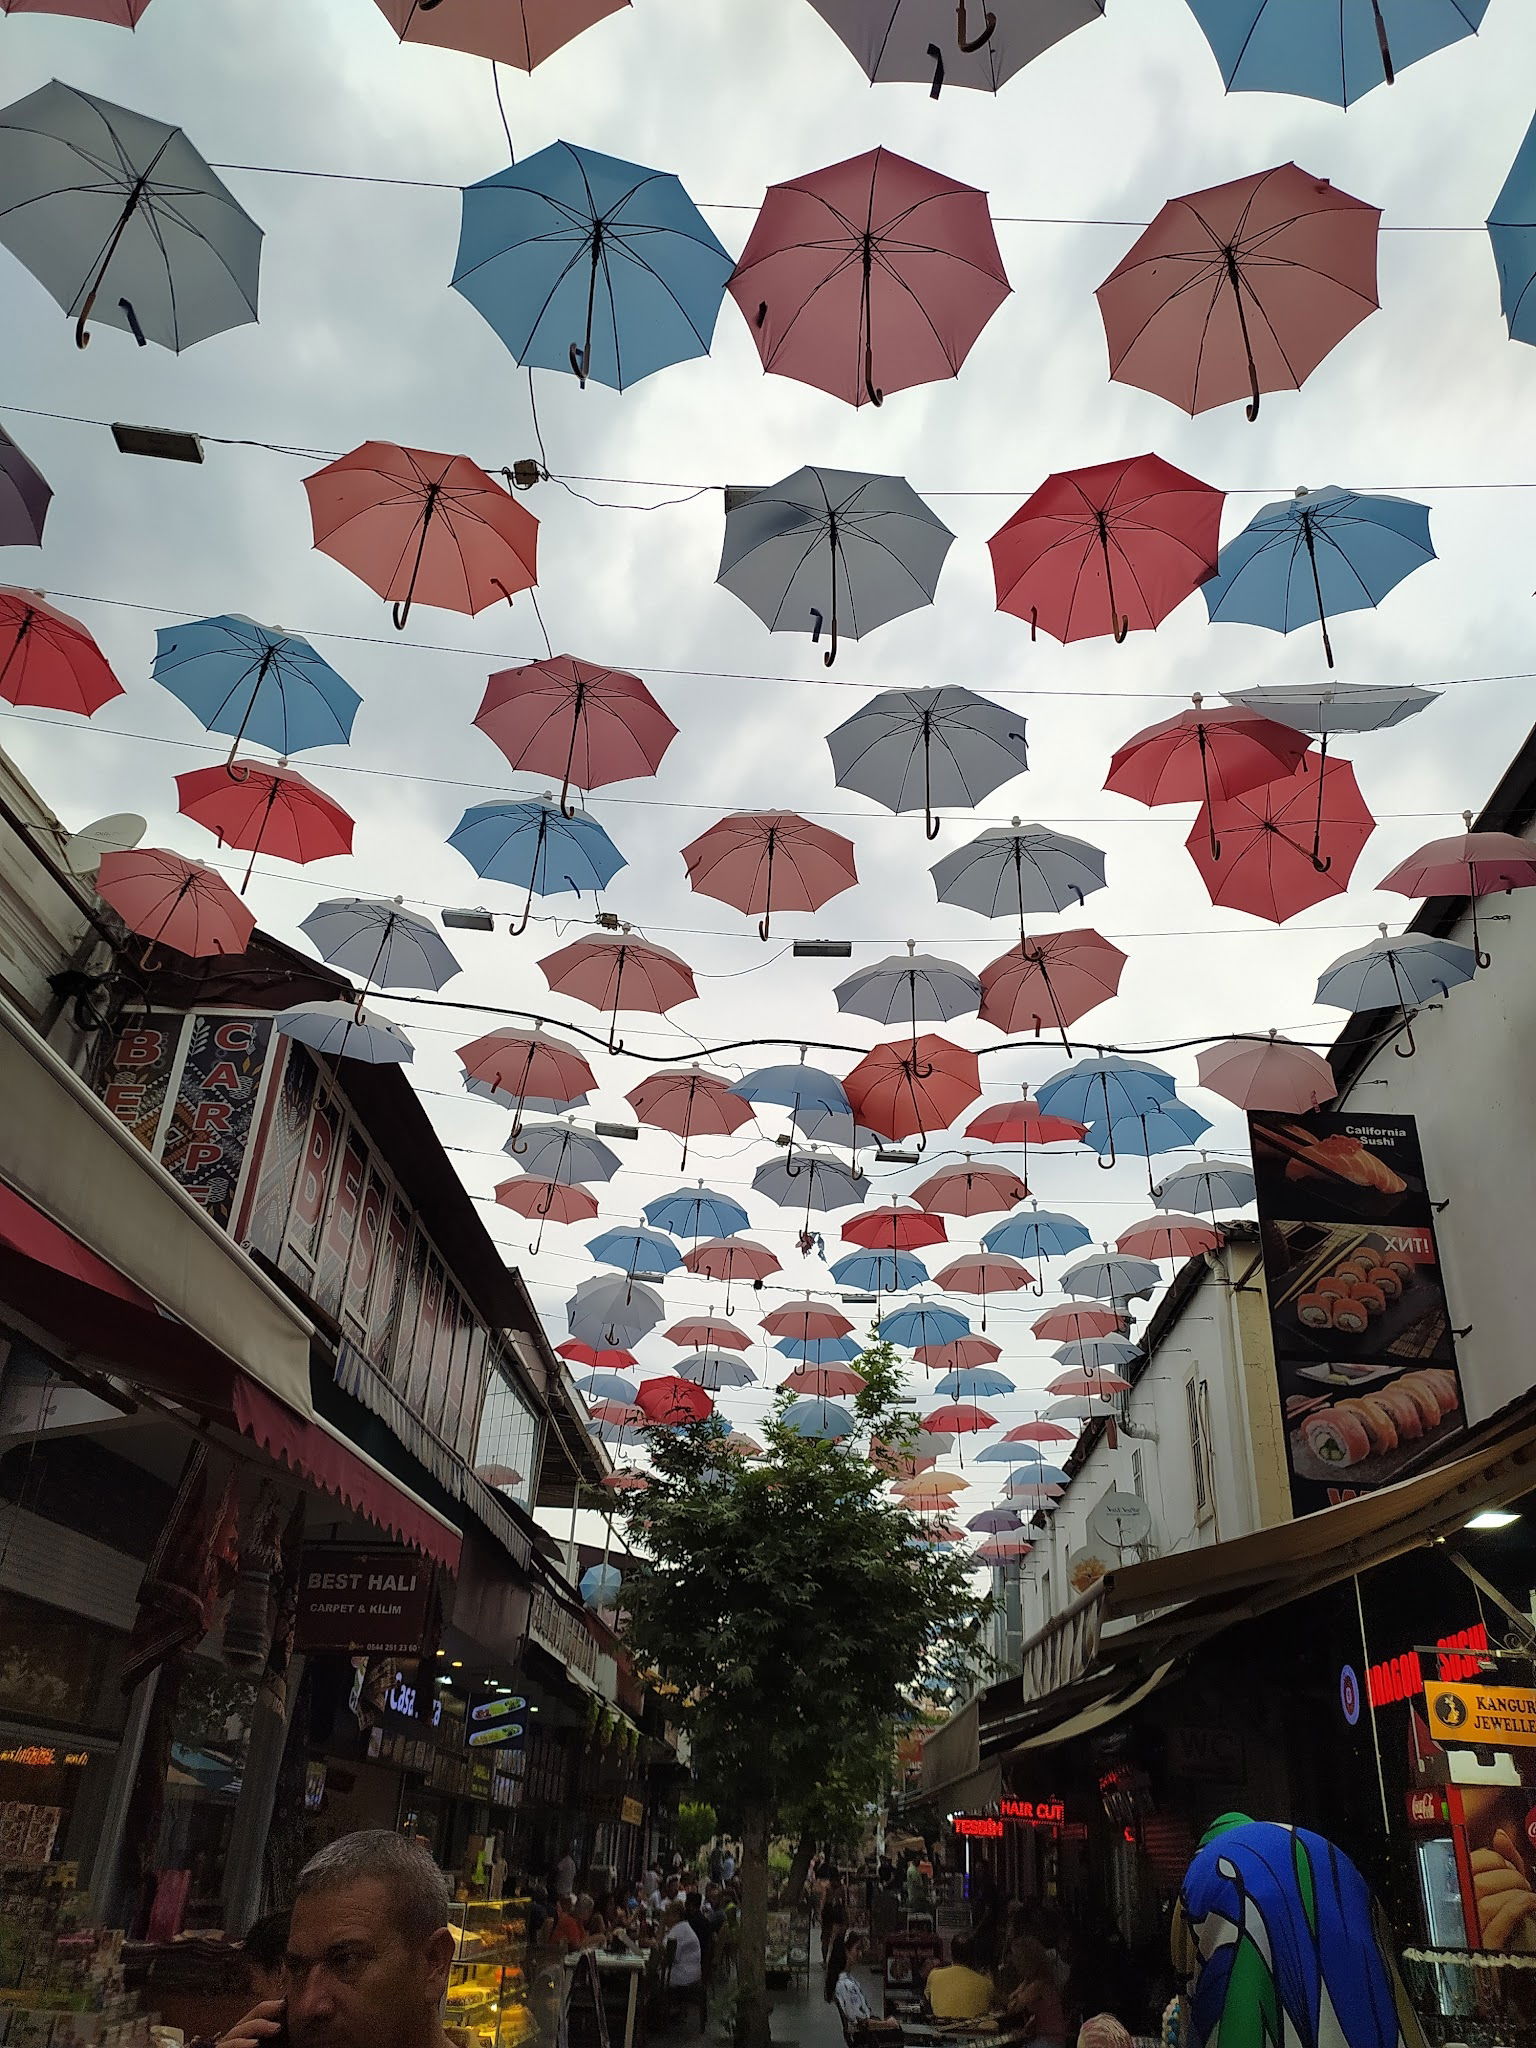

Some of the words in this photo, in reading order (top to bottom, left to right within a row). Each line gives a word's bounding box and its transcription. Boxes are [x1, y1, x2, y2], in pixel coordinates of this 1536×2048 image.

[1345, 1126, 1407, 1137] California
[1360, 1136, 1395, 1146] Sushi
[307, 1572, 363, 1590] BEST
[367, 1574, 417, 1592] HALI
[309, 1603, 354, 1614] CARPET
[357, 1604, 366, 1614] &
[1001, 1800, 1033, 1817] HAIR
[1036, 1803, 1064, 1820] CUT
